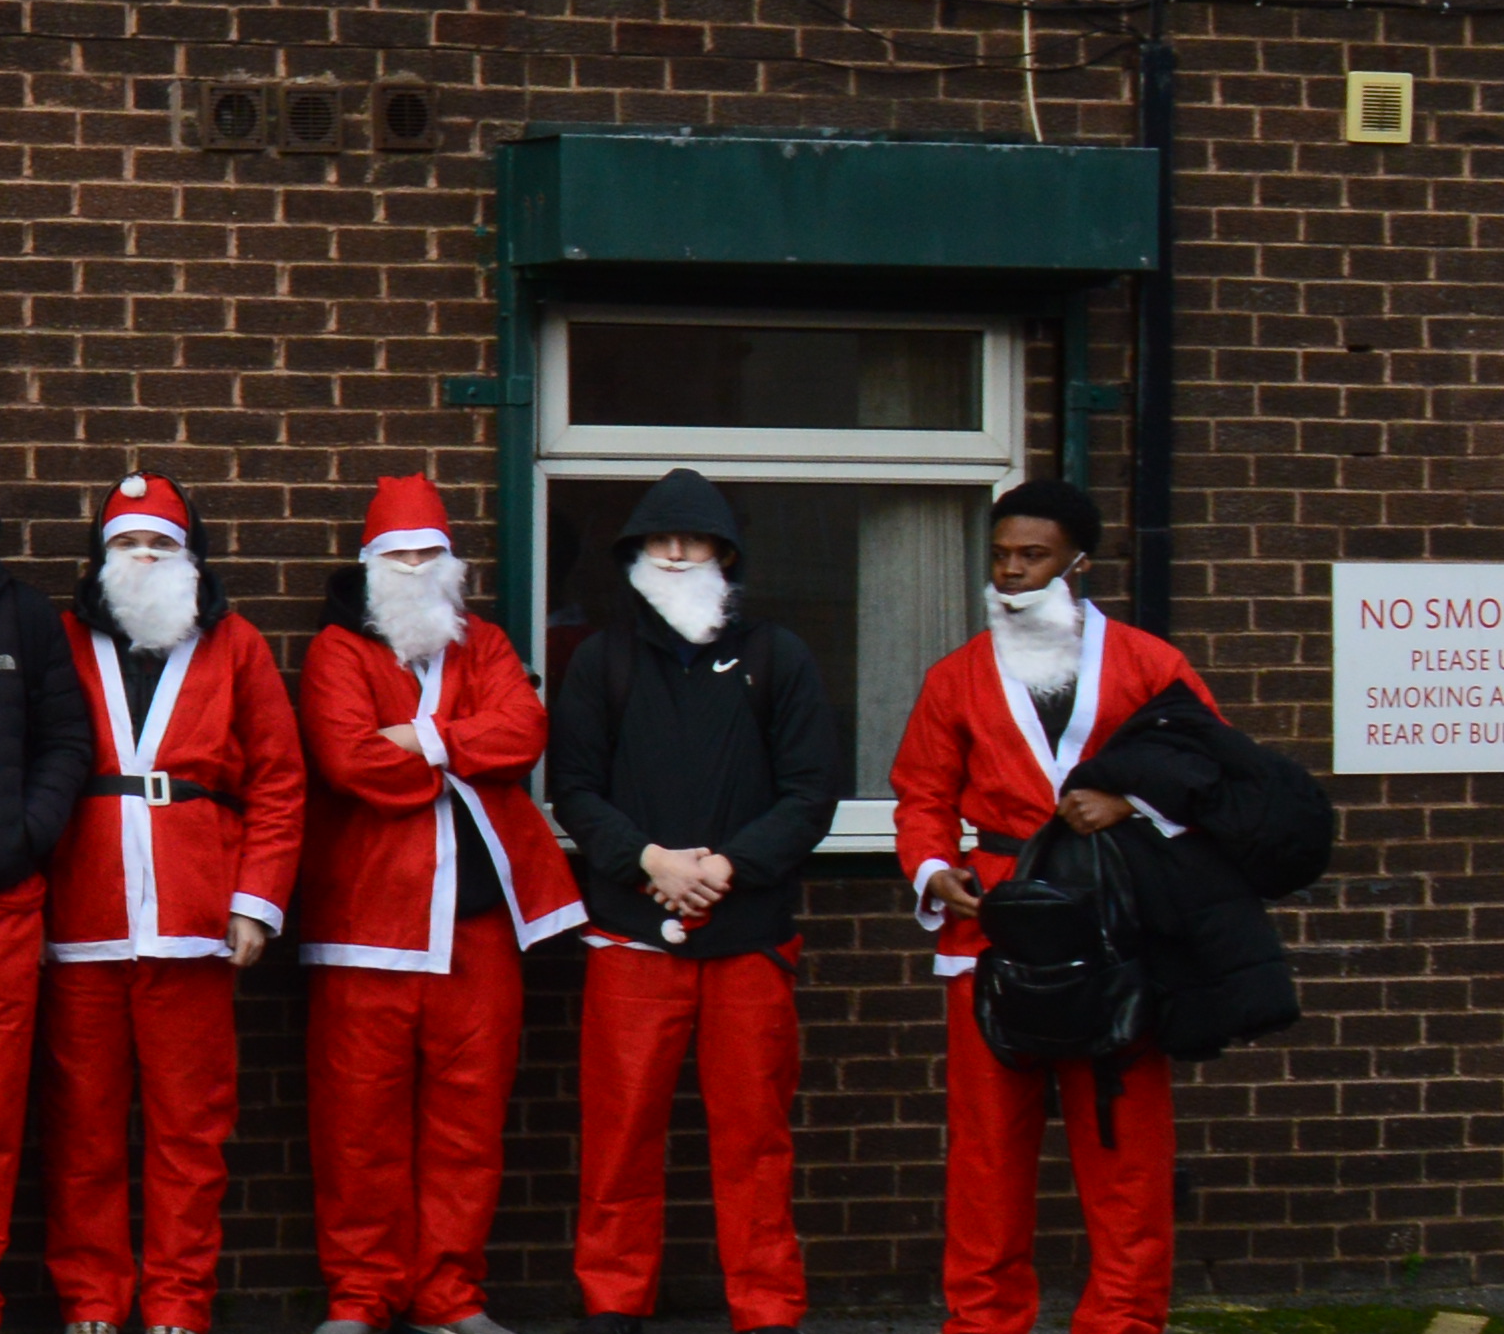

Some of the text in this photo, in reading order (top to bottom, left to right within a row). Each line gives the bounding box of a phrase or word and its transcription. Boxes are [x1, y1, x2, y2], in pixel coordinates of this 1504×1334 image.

[1360, 597, 1502, 630] NO SMO
[1411, 648, 1490, 672] PLEASE
[1366, 685, 1483, 709] SMOKING
[1366, 723, 1425, 746] REAR
[1431, 722, 1462, 745] OF
